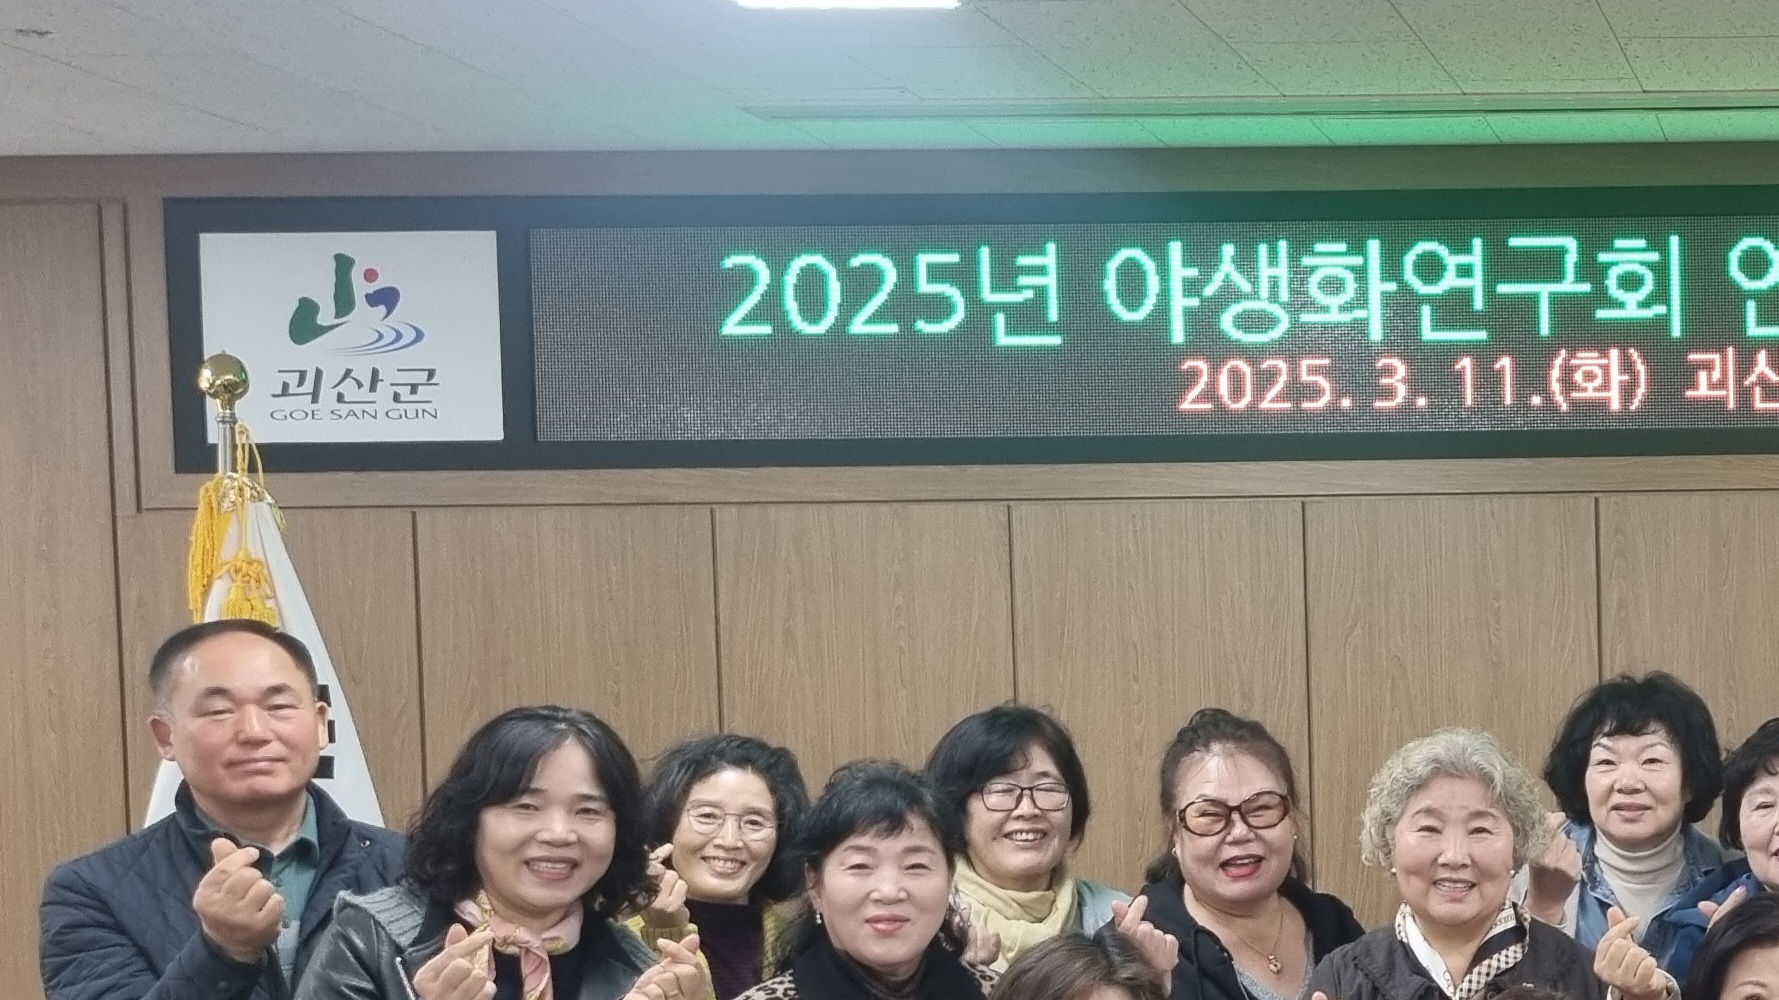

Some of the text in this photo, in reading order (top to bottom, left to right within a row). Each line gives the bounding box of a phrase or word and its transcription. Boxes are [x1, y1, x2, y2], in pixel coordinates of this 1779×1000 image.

[719, 240, 1063, 346] 2025년
[1103, 234, 1682, 345] 야생화연구회
[270, 366, 440, 405] 괴산군
[1178, 357, 1353, 411] 2025.
[1373, 355, 1428, 410] 3.
[270, 407, 439, 422] GOE SAN GUN
